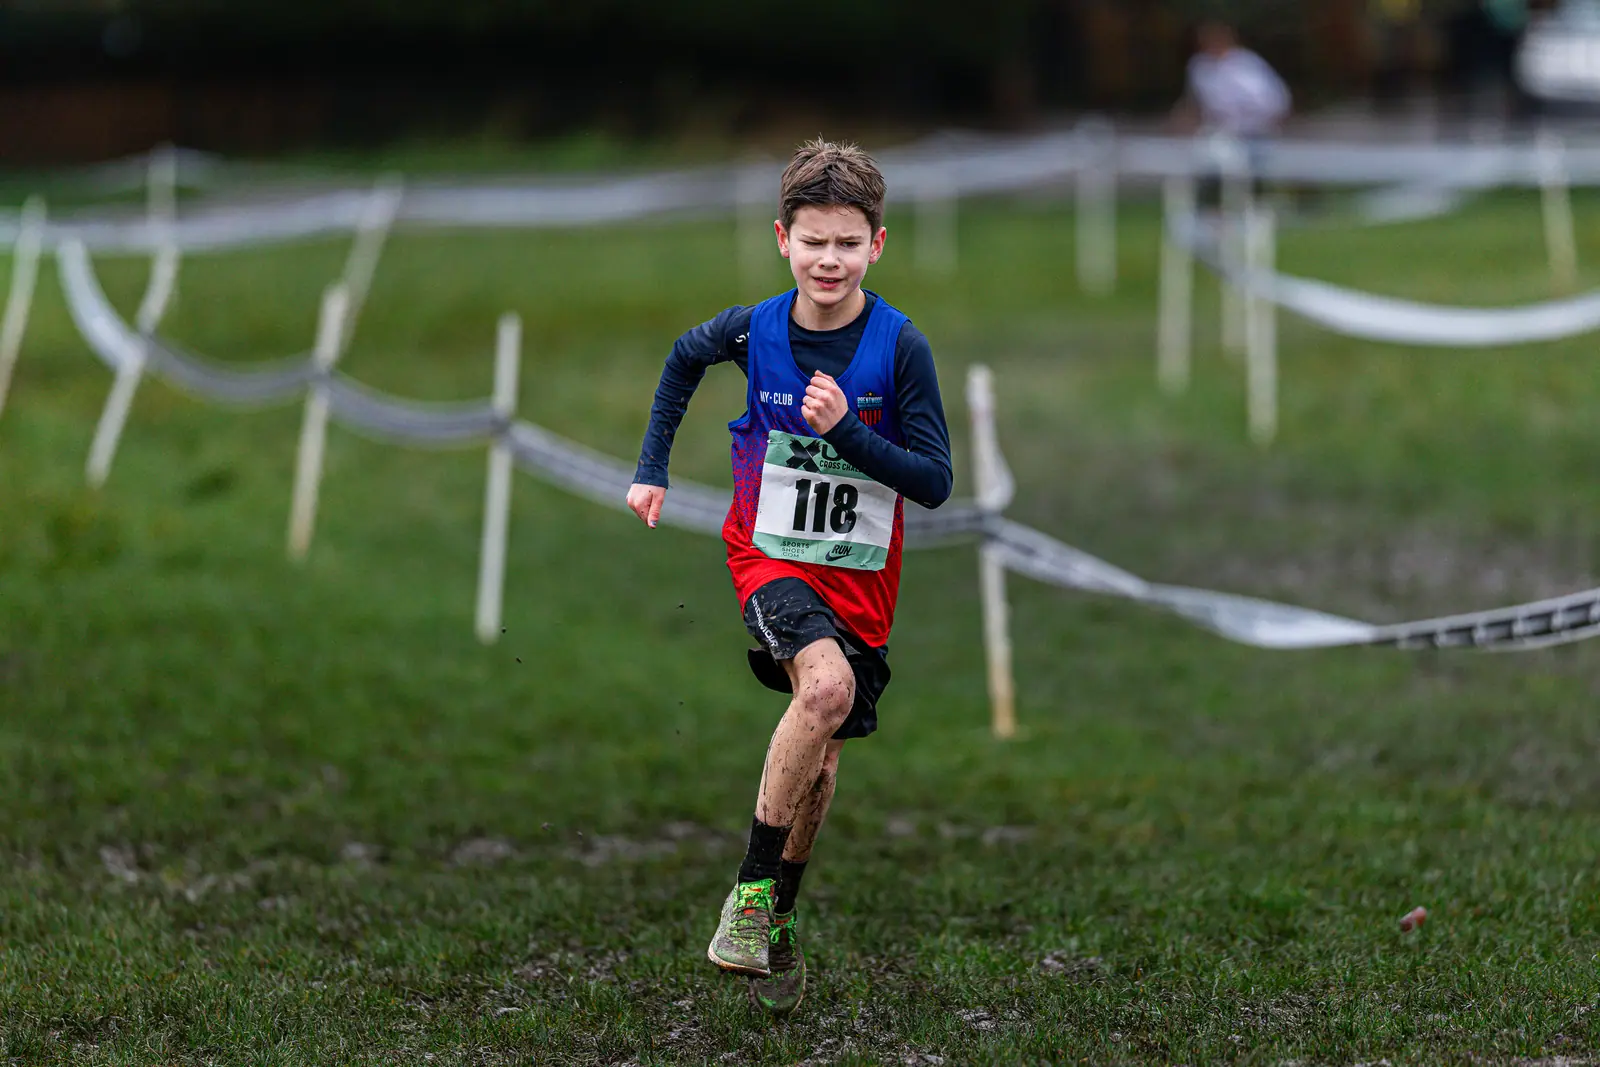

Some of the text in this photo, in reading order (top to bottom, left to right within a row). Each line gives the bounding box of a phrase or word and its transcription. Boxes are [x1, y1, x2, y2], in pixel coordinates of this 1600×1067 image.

[819, 459, 841, 470] CROSS
[792, 478, 859, 534] 118
[782, 541, 810, 549] SPORTS
[831, 544, 853, 556] RUN
[782, 547, 805, 555] SHOES
